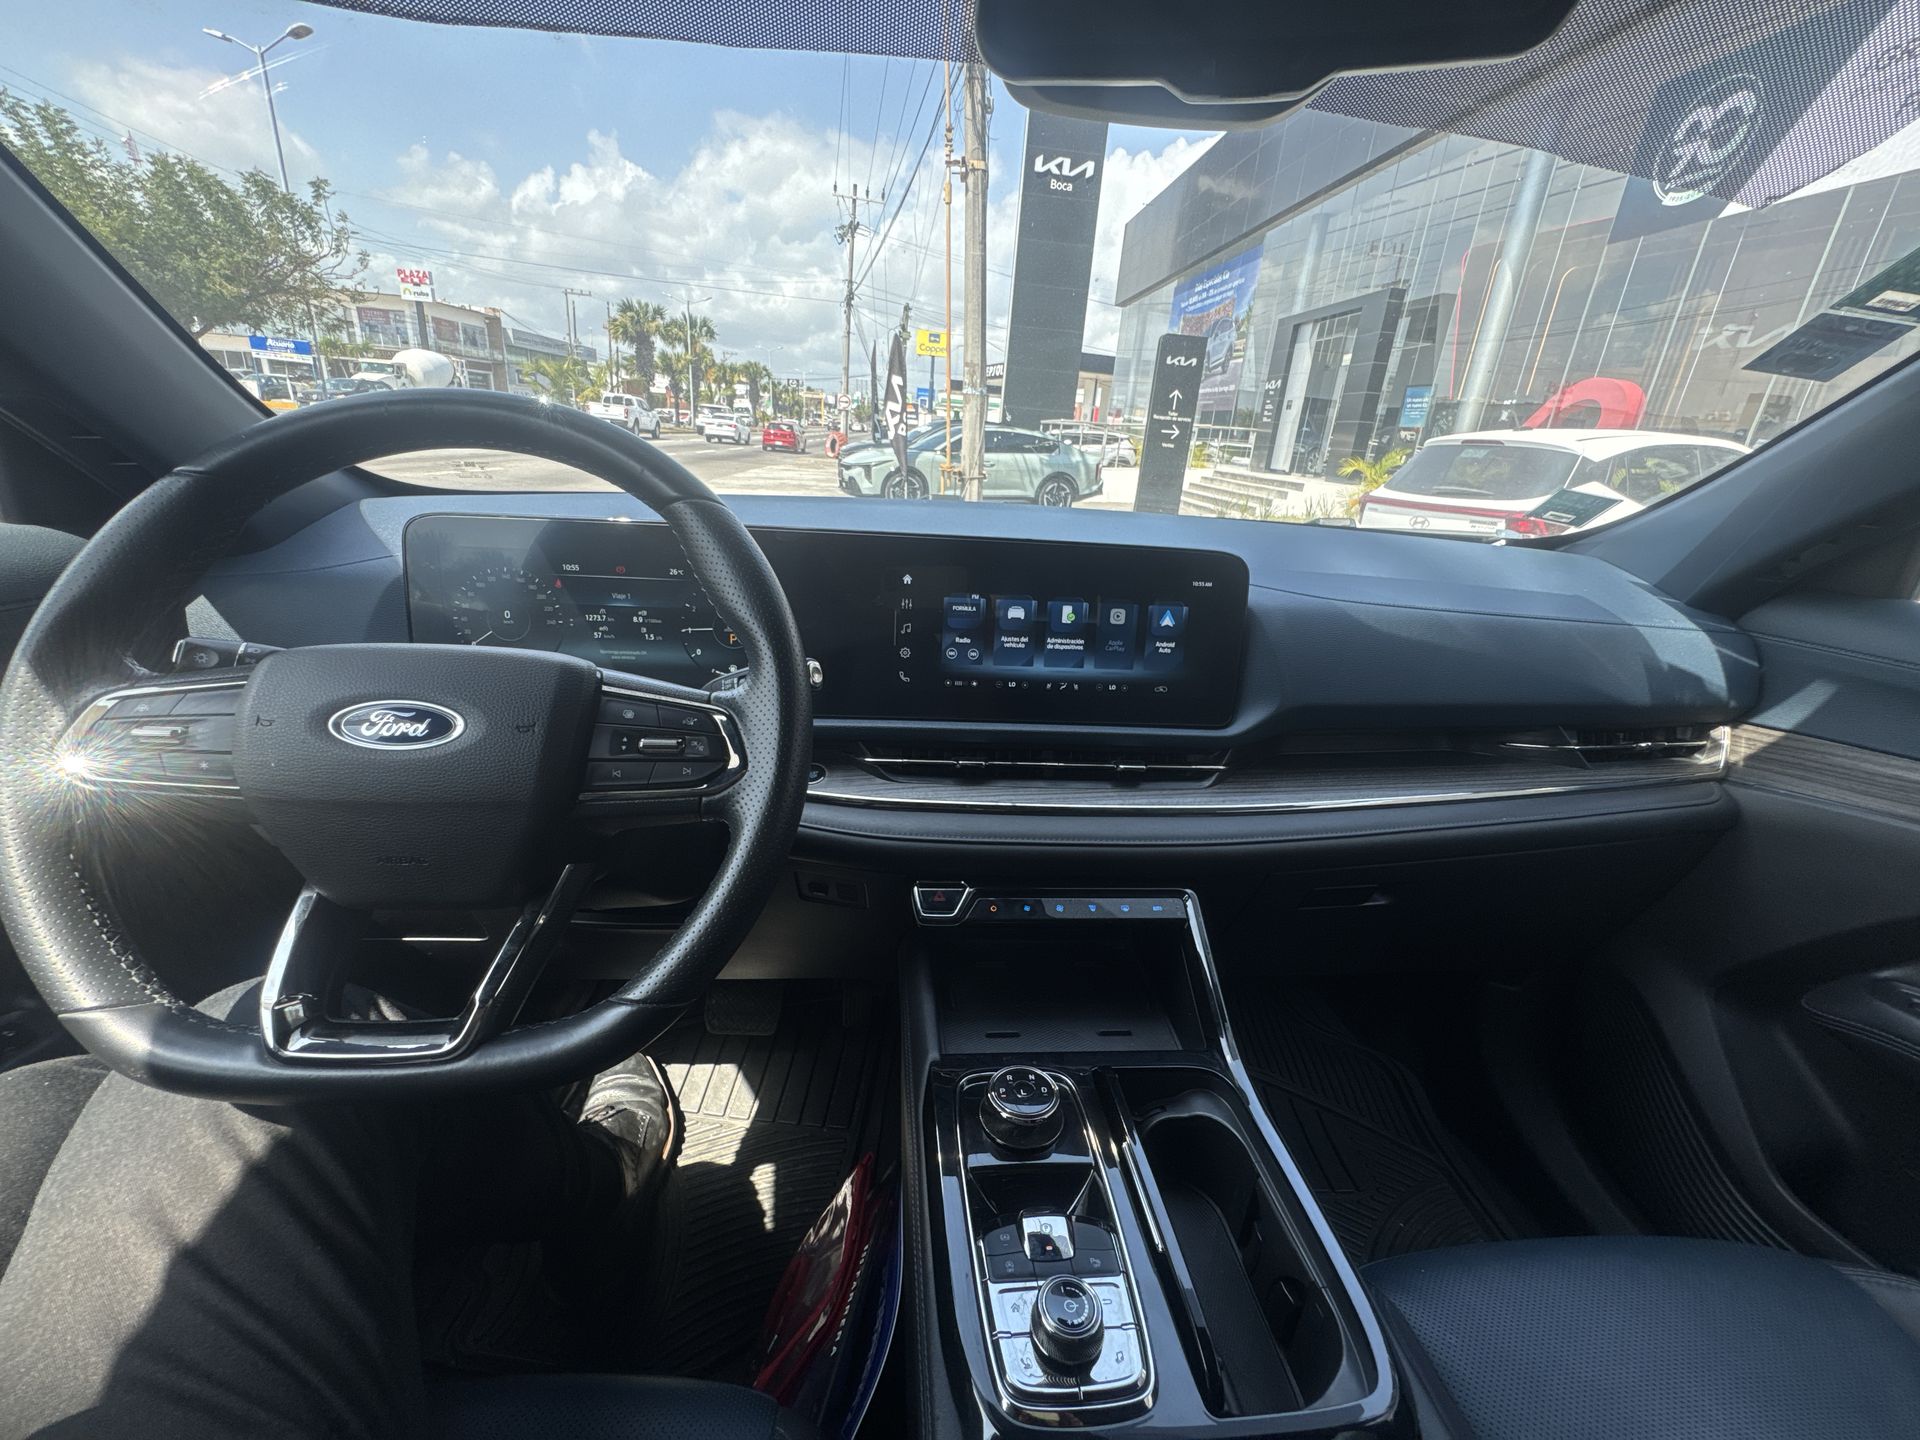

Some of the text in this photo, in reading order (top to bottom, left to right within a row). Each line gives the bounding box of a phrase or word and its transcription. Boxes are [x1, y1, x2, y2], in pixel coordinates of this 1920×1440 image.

[1034, 154, 1095, 179] KIA
[1050, 179, 1073, 191] Boca
[396, 268, 428, 278] PLAZA
[919, 343, 946, 354] Coppe
[1166, 355, 1197, 367] KIA
[611, 593, 627, 601] Viaje
[504, 610, 511, 619] 0
[585, 614, 606, 622] 1273.7
[729, 633, 738, 645] P
[1001, 635, 1019, 643] Ajustes
[1054, 643, 1084, 651] dispositivos
[1155, 641, 1176, 649] Android
[696, 648, 702, 656] 0
[360, 709, 432, 737] Ford
